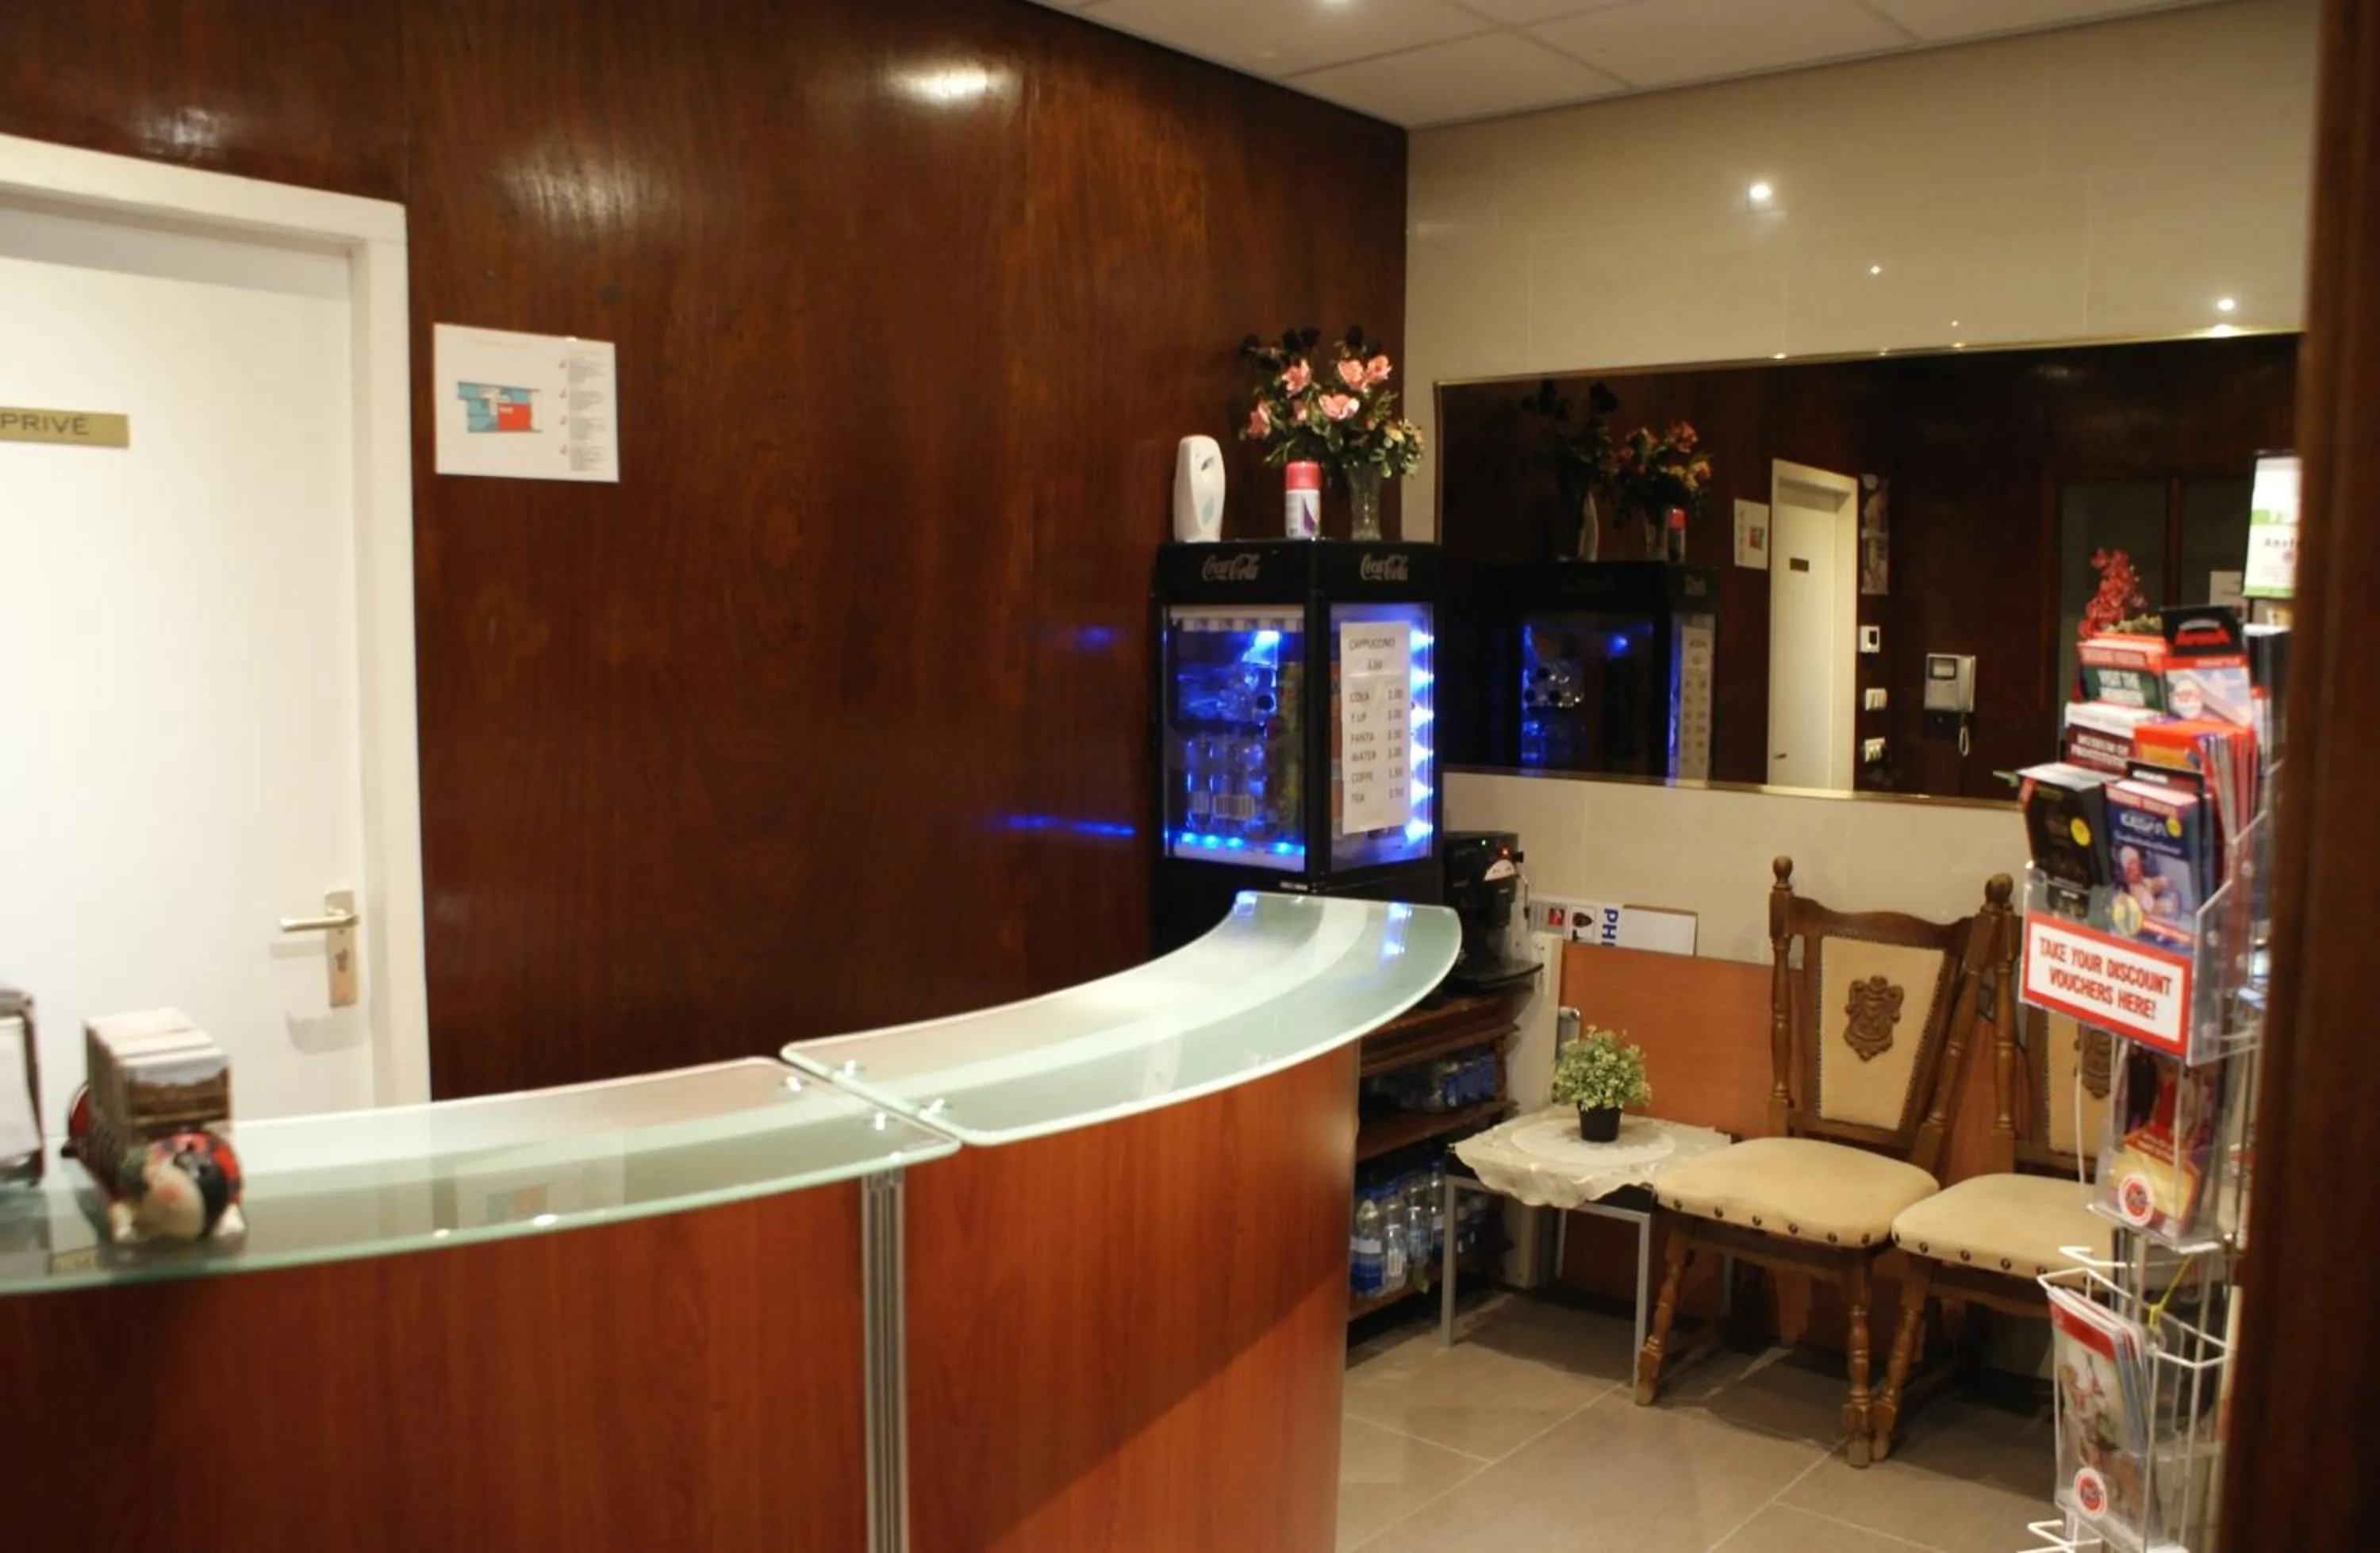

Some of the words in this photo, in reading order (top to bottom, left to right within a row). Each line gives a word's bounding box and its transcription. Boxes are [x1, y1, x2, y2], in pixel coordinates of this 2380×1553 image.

[2039, 936, 2067, 963] TAKE
[2071, 947, 2103, 975] YOUR
[2107, 958, 2172, 997] DISCOUNT
[2048, 966, 2114, 1006] VOUCHERS
[2117, 989, 2157, 1021] HERE!
